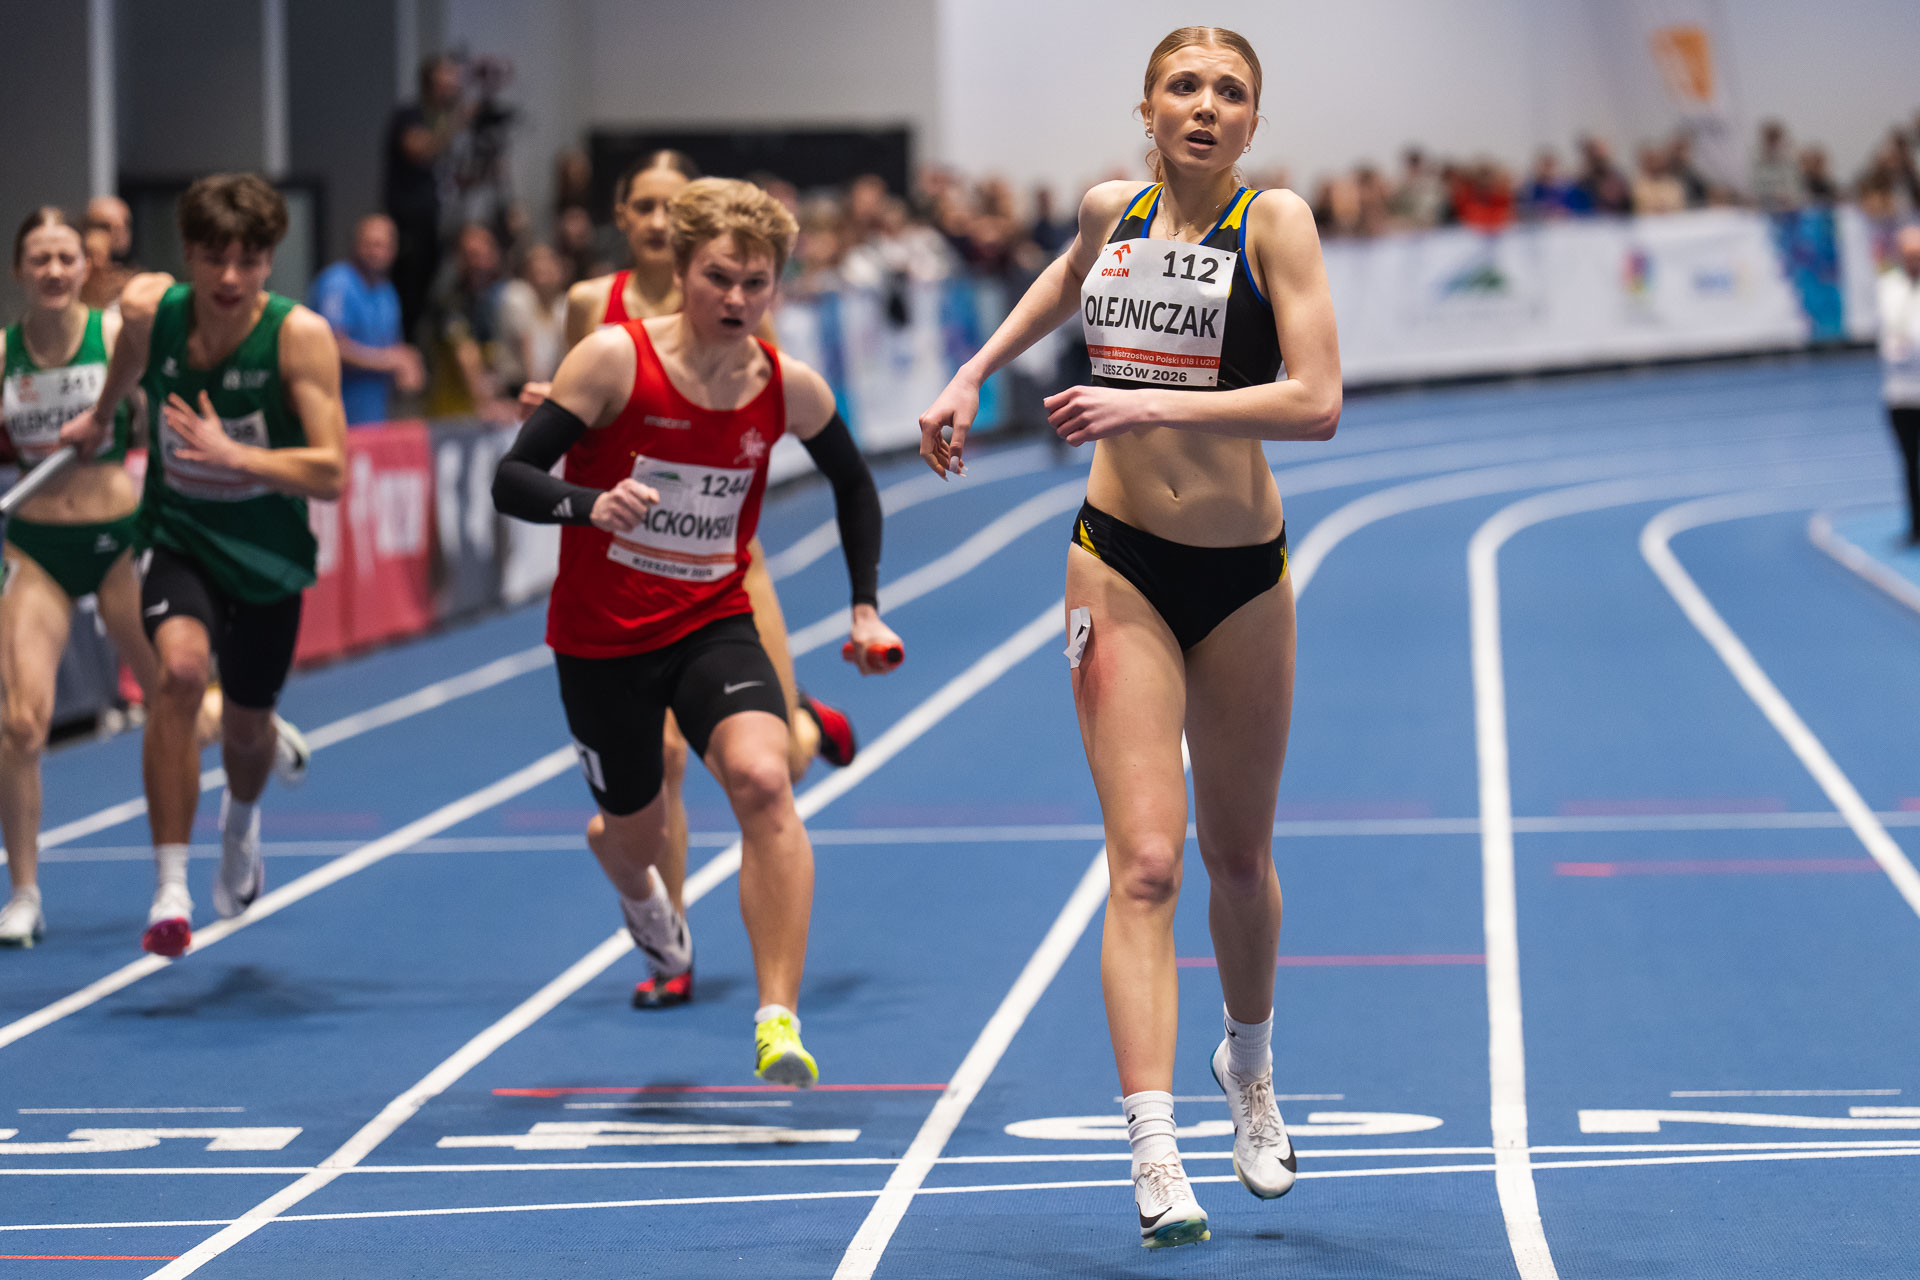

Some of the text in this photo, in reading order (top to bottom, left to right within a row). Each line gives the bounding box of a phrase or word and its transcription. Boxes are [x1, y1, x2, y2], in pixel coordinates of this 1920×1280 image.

[1101, 267, 1130, 277] ORLEN
[1162, 251, 1219, 284] 112
[1085, 295, 1219, 338] OLEJNICZAK
[1112, 350, 1155, 362] Mistrzostwa
[1156, 356, 1179, 365] Polski
[1180, 356, 1195, 365] U18
[1200, 358, 1216, 366] U20
[1102, 363, 1187, 383] RZESZÓW 2026
